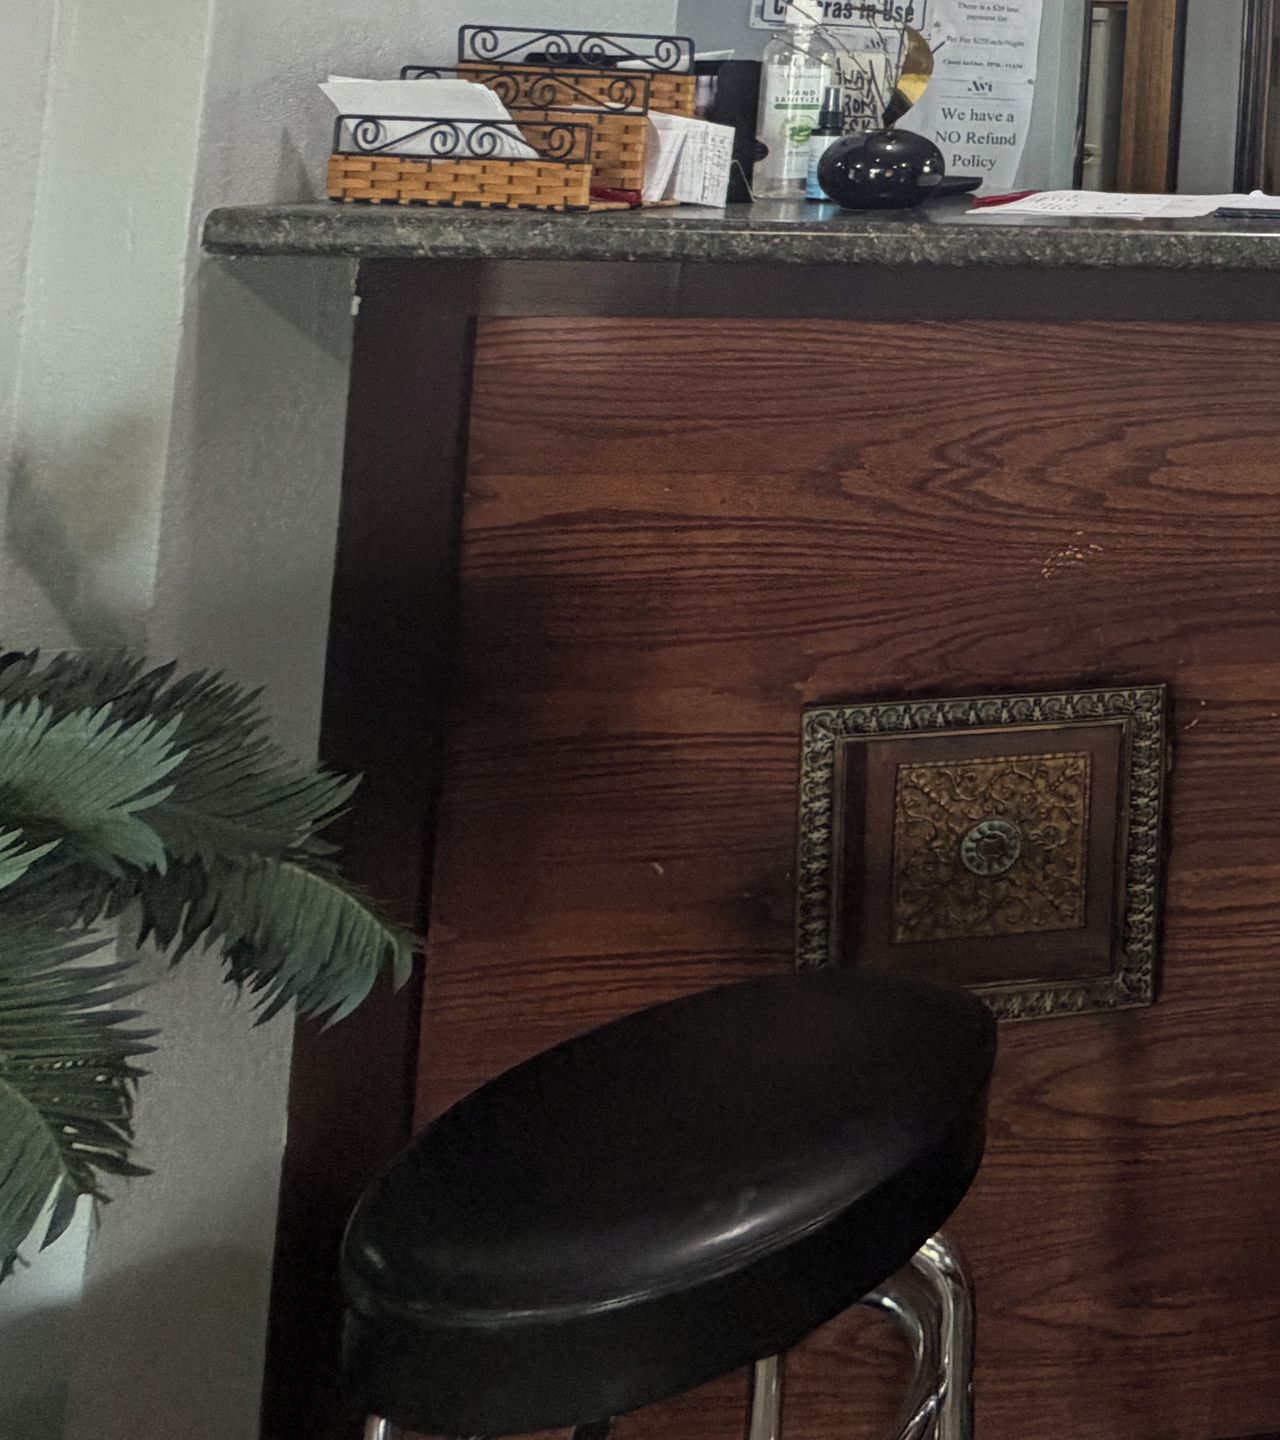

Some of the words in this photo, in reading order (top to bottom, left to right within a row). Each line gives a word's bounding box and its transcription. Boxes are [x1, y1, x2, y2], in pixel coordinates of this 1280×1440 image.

[941, 107, 965, 120] We
[970, 108, 1003, 122] have
[1006, 113, 1014, 122] a
[935, 130, 961, 144] NO
[966, 131, 1016, 146] Refund
[952, 154, 997, 171] Policy
